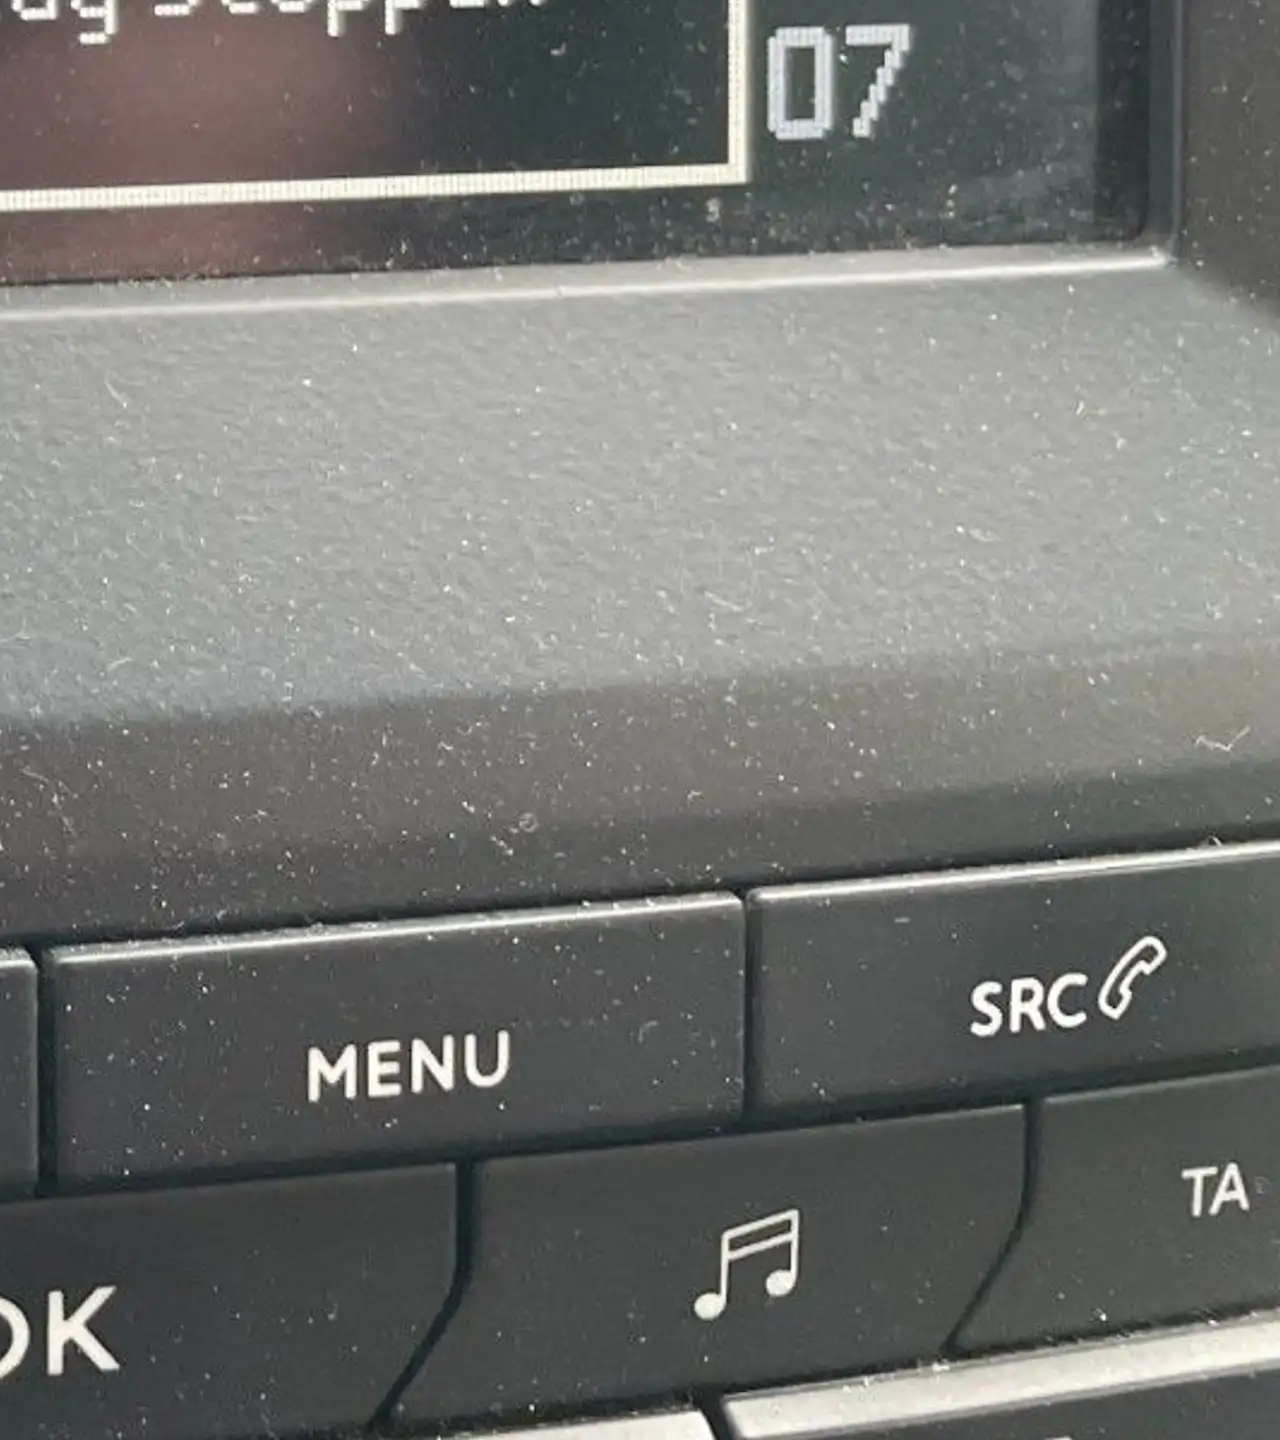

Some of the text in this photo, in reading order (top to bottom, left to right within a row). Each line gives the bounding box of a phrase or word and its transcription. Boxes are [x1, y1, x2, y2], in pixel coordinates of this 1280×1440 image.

[767, 23, 911, 140] 07
[970, 973, 1088, 1037] SRC
[308, 1030, 511, 1103] MENU
[1181, 1162, 1250, 1217] TA
